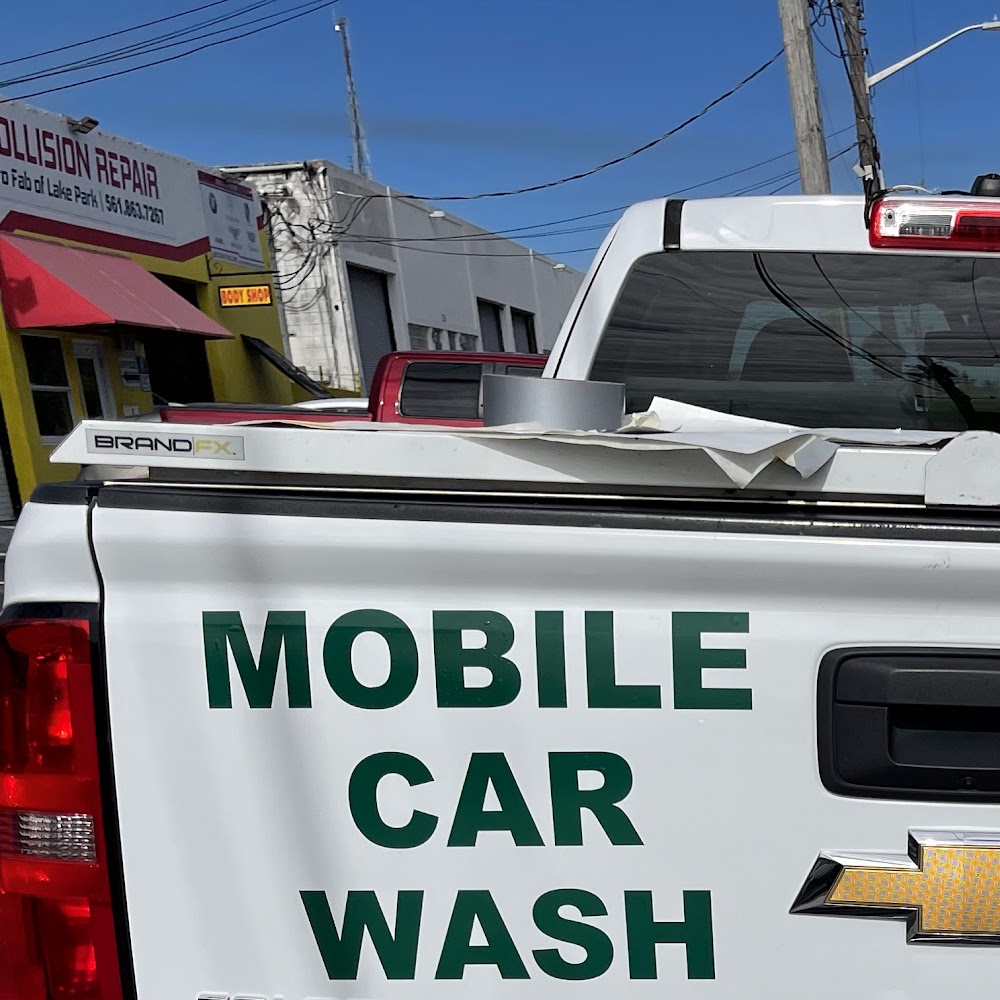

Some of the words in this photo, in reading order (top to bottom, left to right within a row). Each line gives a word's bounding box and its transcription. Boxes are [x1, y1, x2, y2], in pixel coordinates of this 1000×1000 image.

[11, 168, 32, 191] Fab
[34, 175, 45, 194] of
[47, 177, 73, 202] Lake
[74, 185, 98, 208] Park
[95, 147, 160, 199] REPAIR
[221, 289, 244, 304] BODY
[246, 286, 269, 302] SHOP
[202, 609, 753, 710] MOBILE
[348, 751, 645, 849] CAR
[299, 888, 716, 981] WASH
